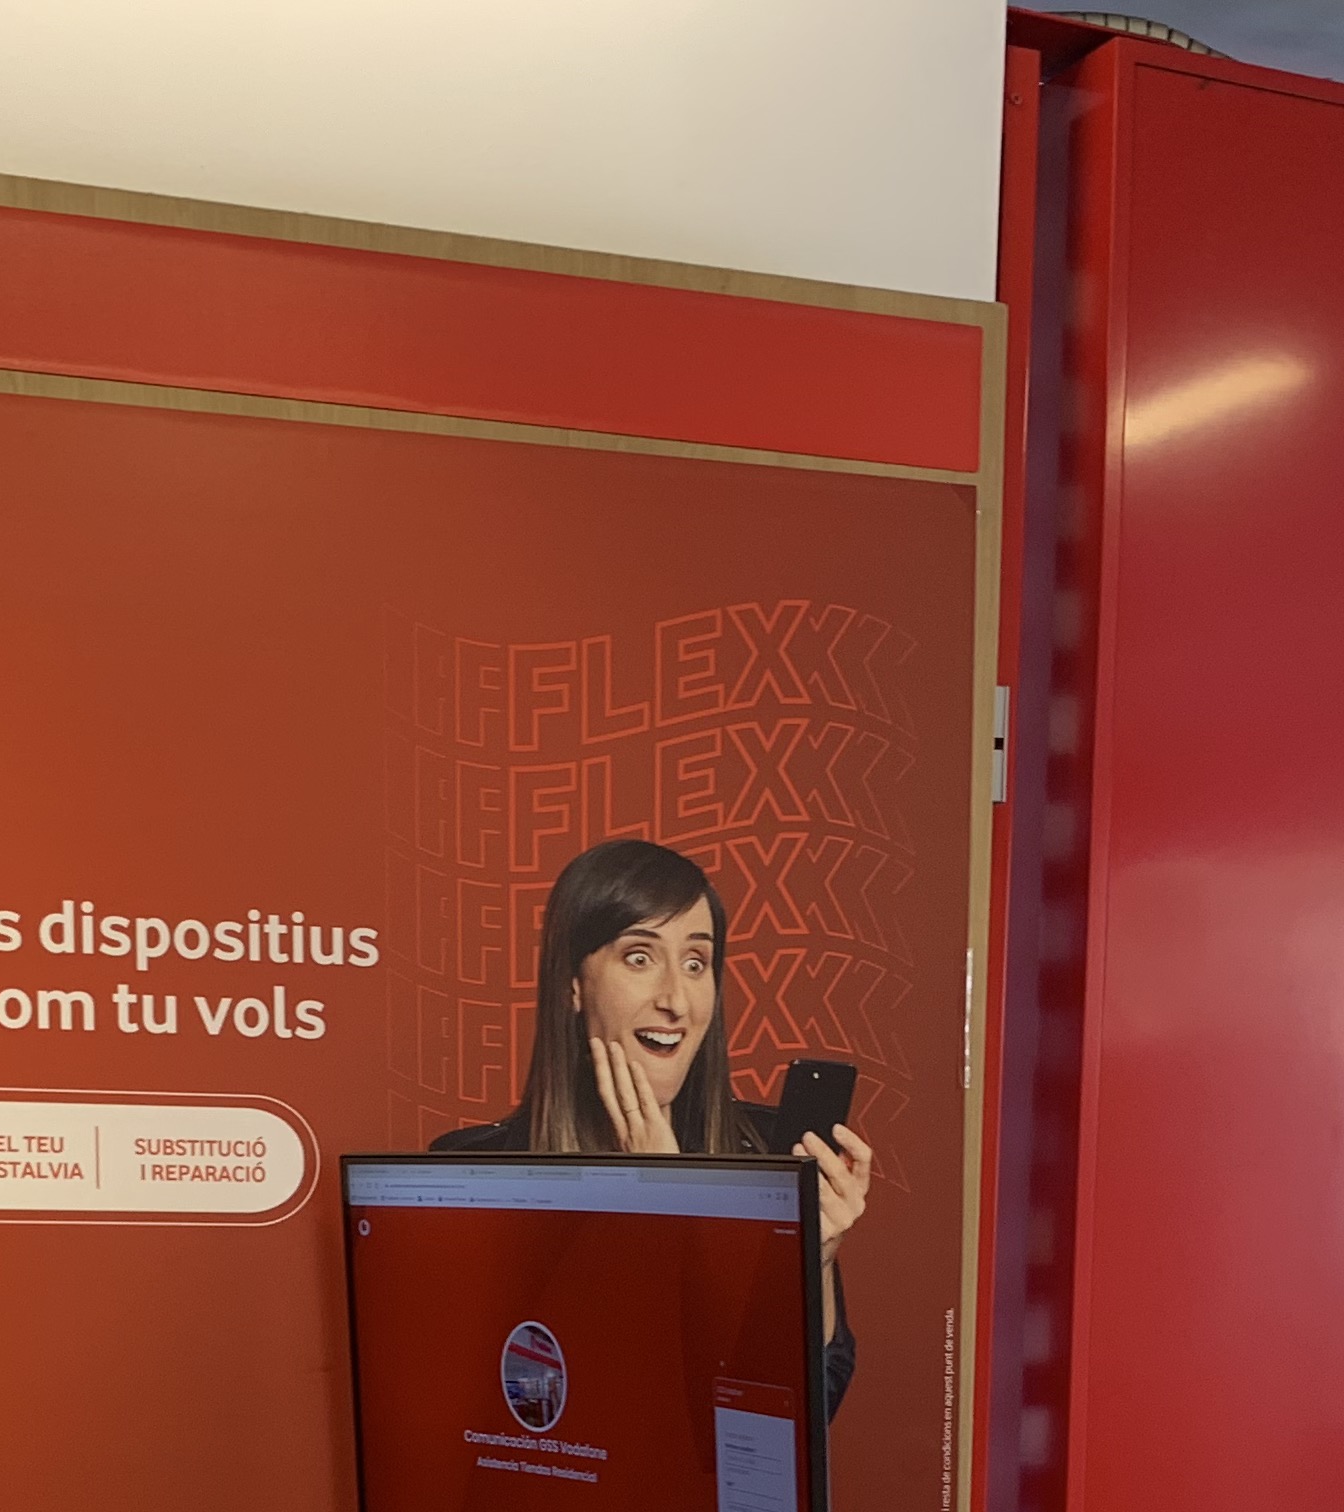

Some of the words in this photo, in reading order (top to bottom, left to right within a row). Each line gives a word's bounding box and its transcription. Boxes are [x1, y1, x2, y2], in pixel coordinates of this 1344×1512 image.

[39, 900, 380, 972] dispositius
[113, 983, 179, 1035] tu
[194, 985, 328, 1042] vols
[22, 1135, 66, 1155] TEU
[134, 1133, 268, 1159] SUBSTITUCIÓ
[139, 1164, 147, 1182] I
[148, 1159, 268, 1185] REPARACIÓ
[943, 1338, 954, 1351] de
[943, 1352, 955, 1374] punt
[943, 1375, 955, 1406] aquest
[943, 1407, 953, 1420] en
[941, 1421, 953, 1471] condicions
[940, 1471, 951, 1484] de
[941, 1484, 951, 1508] resta
